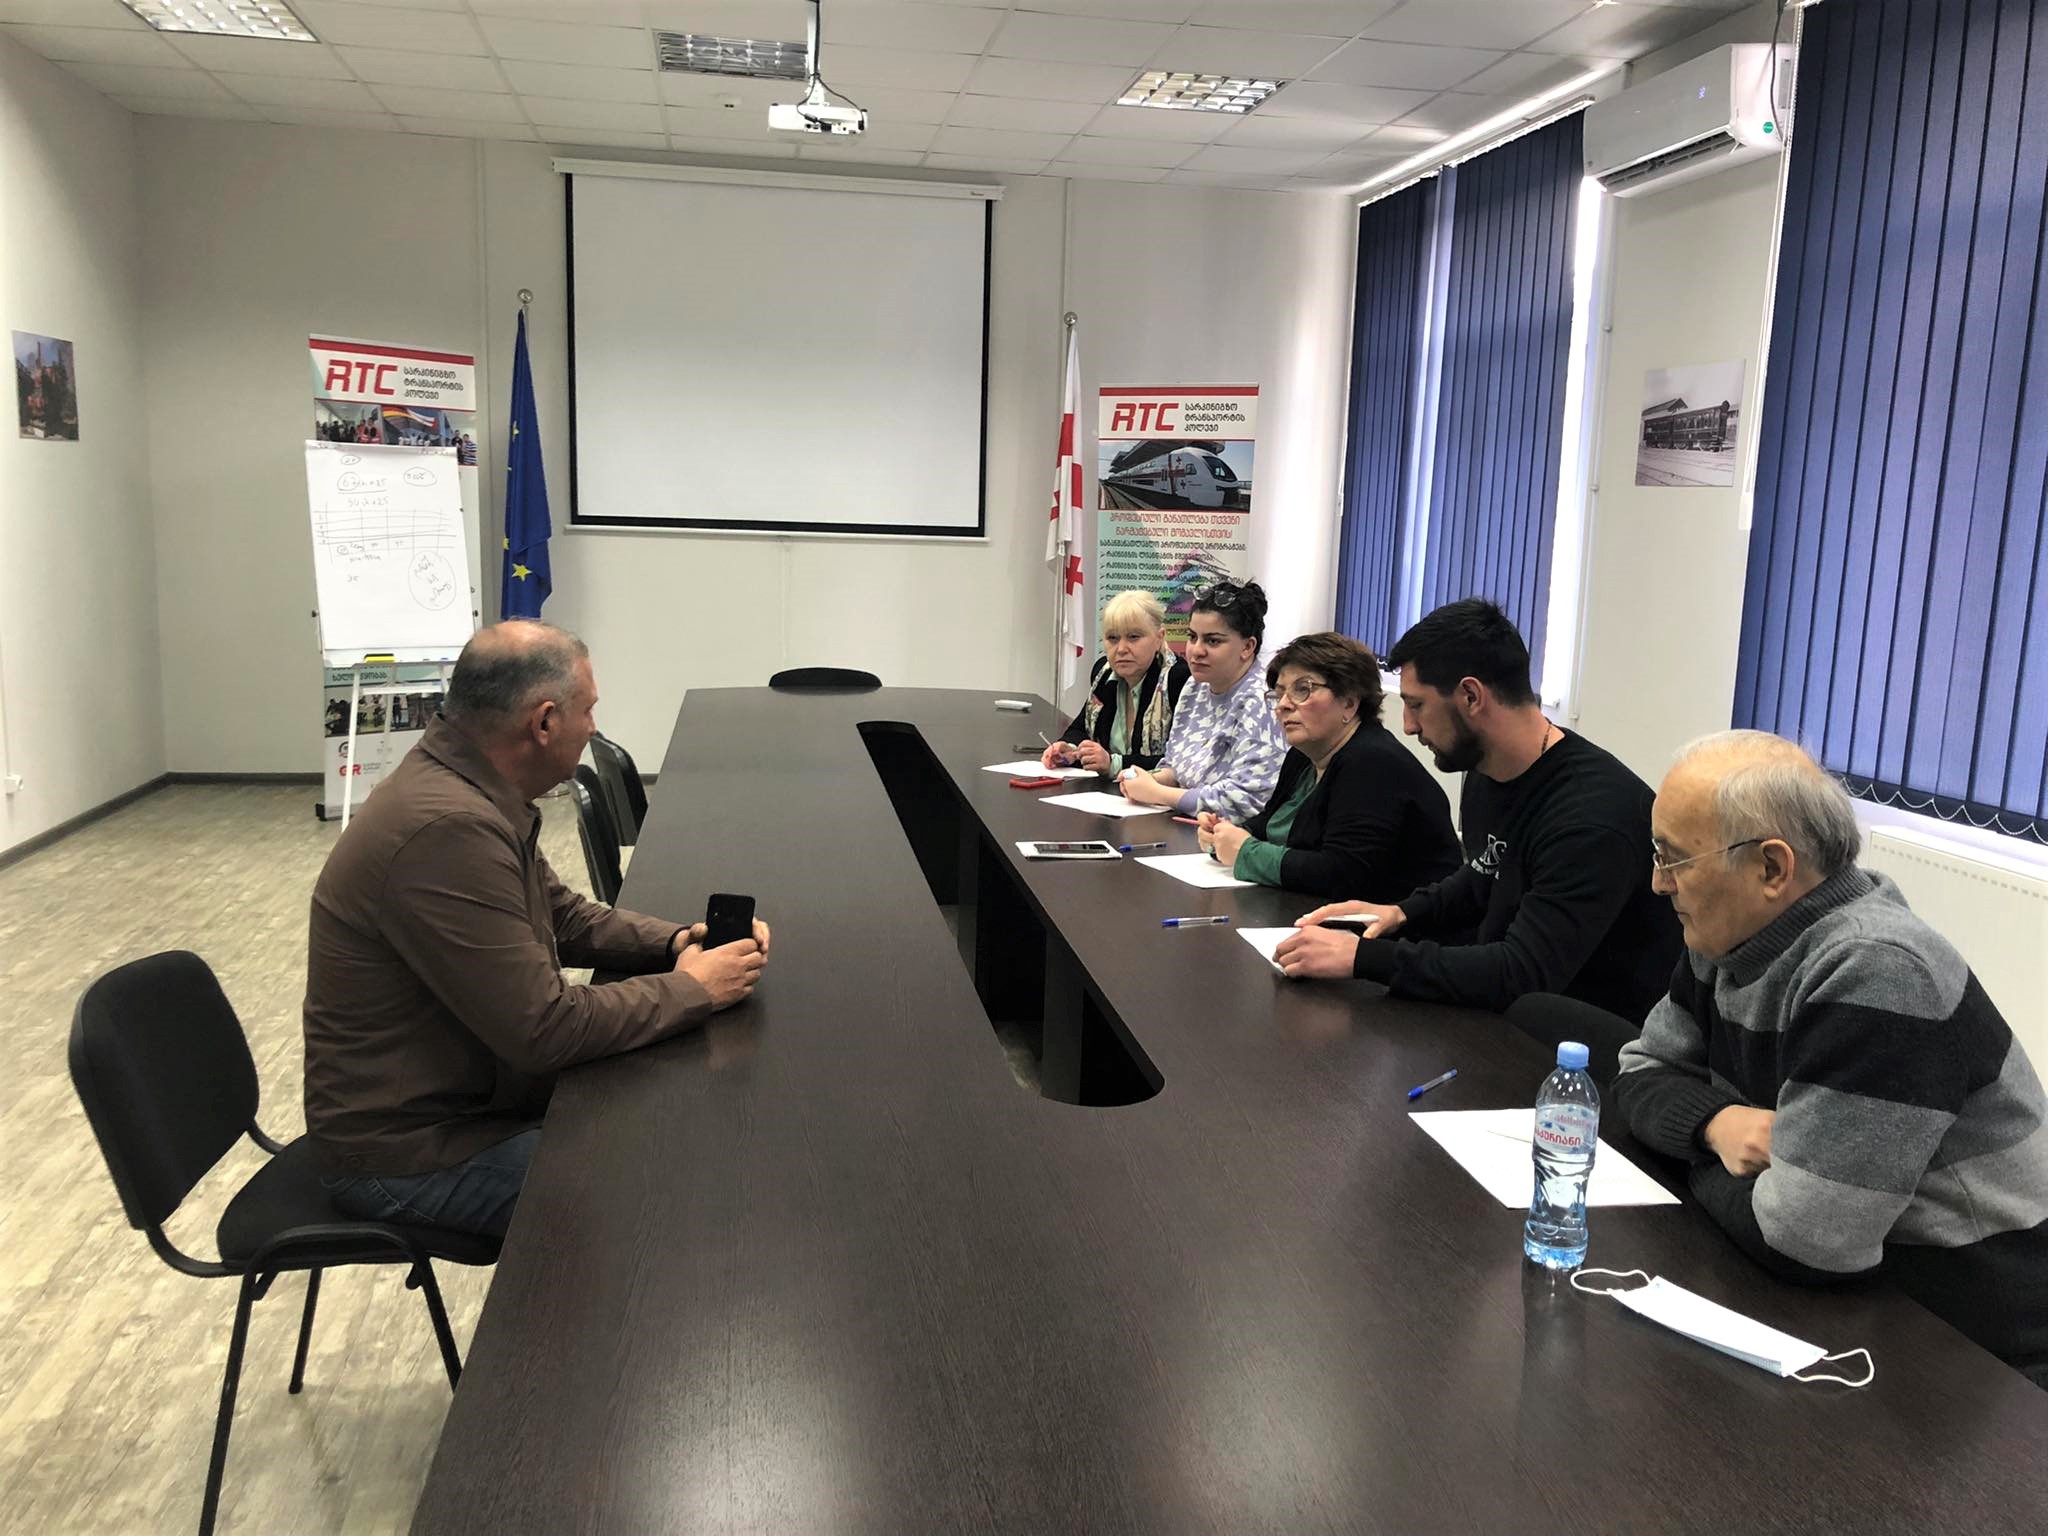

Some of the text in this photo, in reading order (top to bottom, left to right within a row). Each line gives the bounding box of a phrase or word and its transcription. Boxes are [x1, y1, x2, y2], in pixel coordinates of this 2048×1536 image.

[325, 359, 398, 395] RTC
[403, 366, 456, 379] სარკინიგზო
[1184, 402, 1238, 411] სარკინიგზო
[1111, 403, 1179, 431] RTC
[1184, 413, 1246, 421] ტრანსპორტის
[1184, 423, 1219, 432] კოლეჯი
